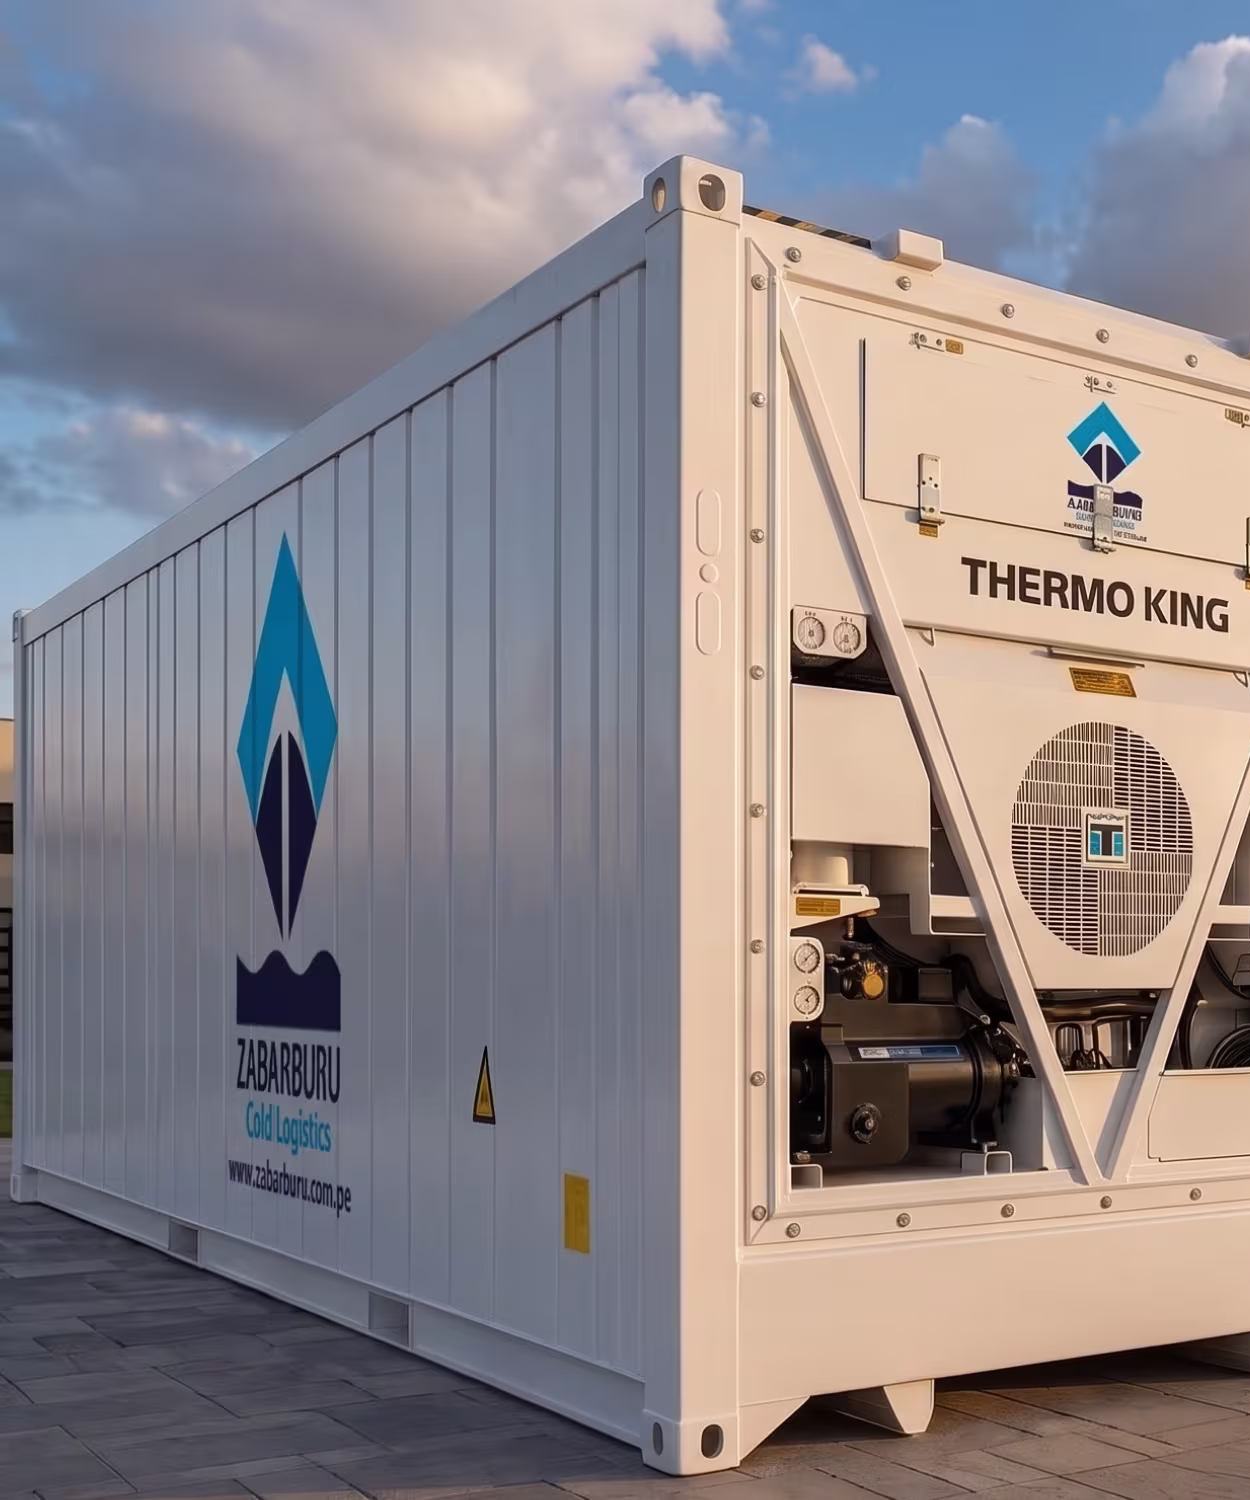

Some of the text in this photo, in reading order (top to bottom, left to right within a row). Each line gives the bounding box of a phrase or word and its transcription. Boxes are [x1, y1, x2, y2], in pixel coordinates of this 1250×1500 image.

[961, 557, 1229, 632] THERMO KING
[237, 1038, 340, 1103] ZABARBURU
[245, 1101, 331, 1155] Cold Logistics
[228, 1159, 351, 1218] www.zabarburu.com.pe
